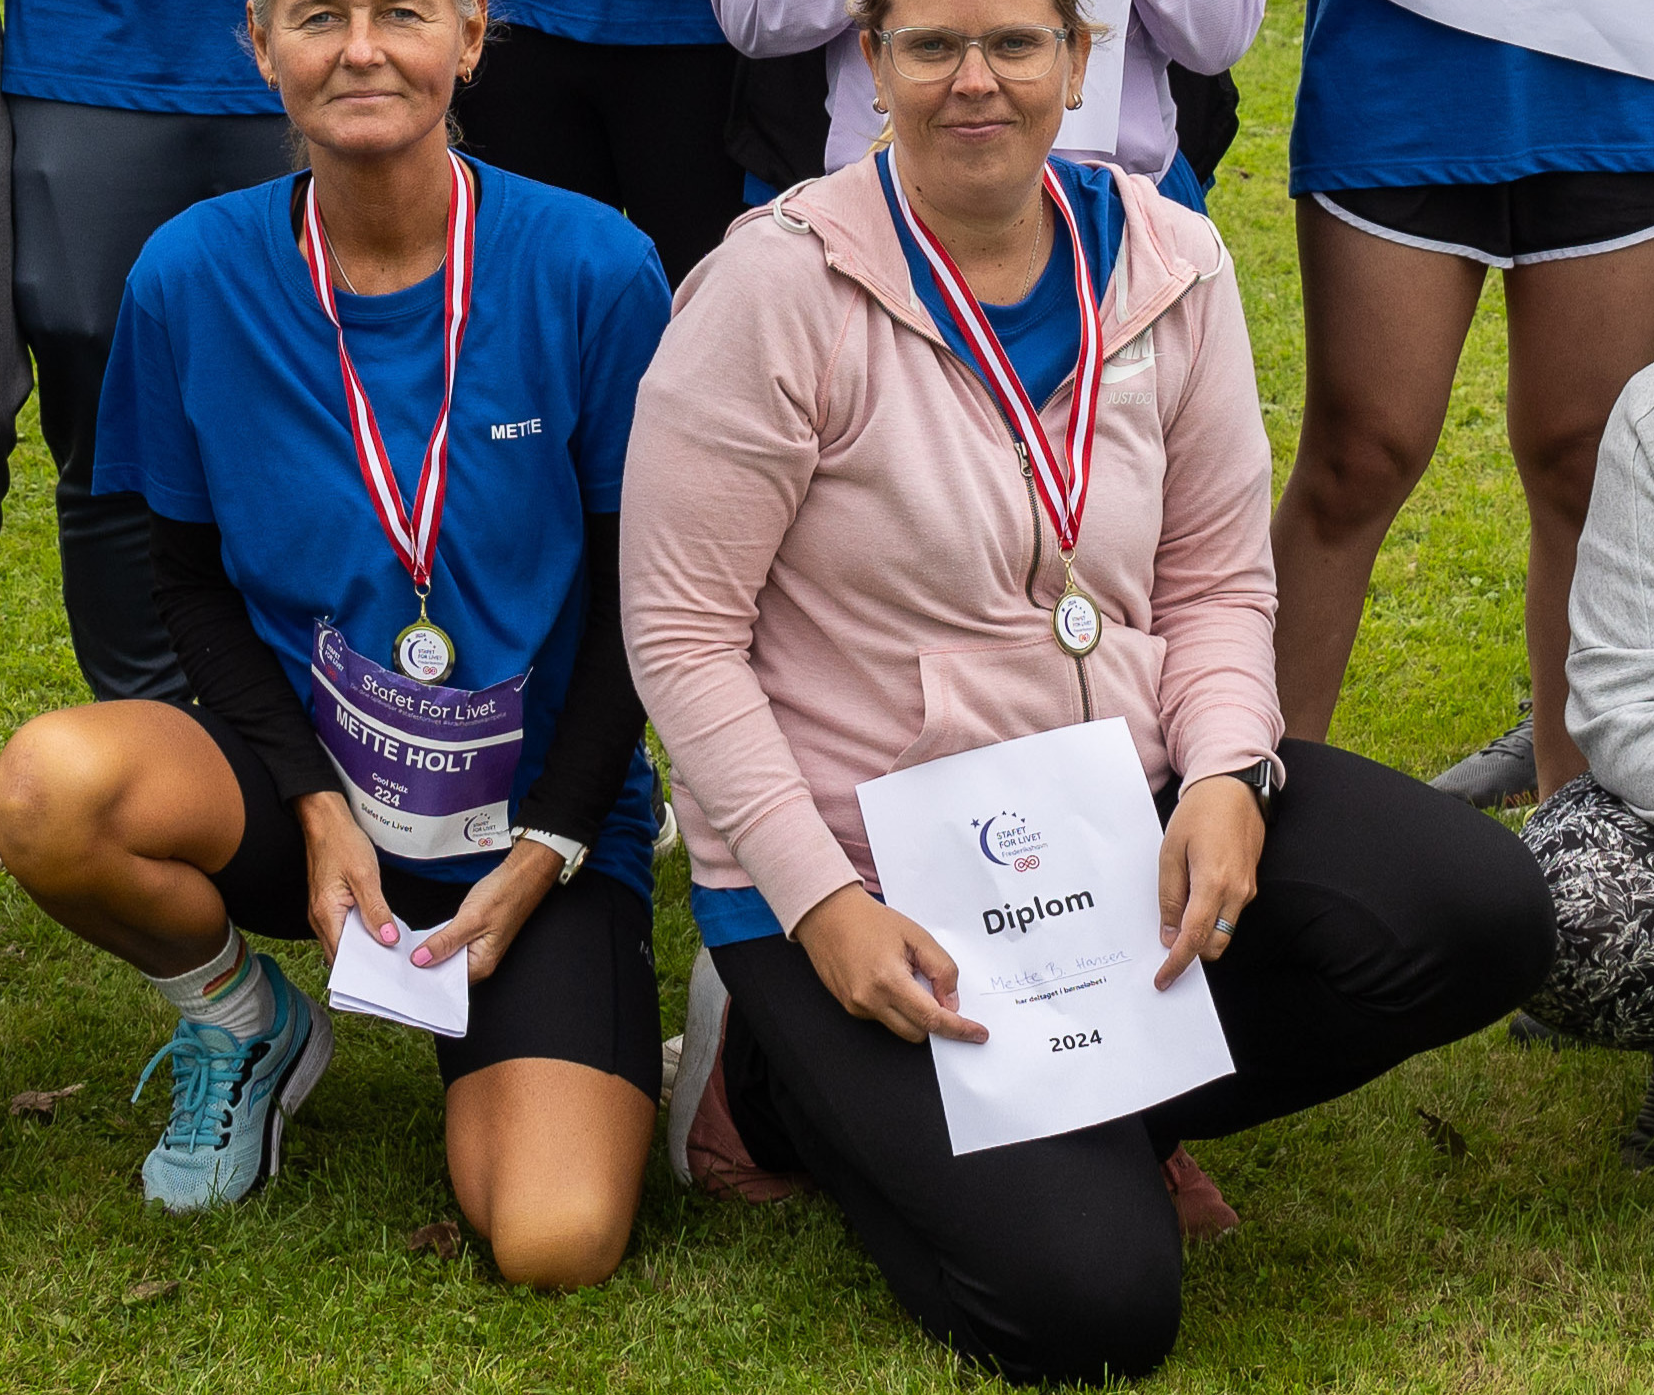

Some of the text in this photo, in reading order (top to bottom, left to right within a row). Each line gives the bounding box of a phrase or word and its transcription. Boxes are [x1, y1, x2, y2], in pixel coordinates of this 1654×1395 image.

[362, 674, 497, 720] Stafet For Livet
[336, 704, 478, 773] METTE HOLT
[371, 772, 409, 794] Cool Kidz
[374, 785, 401, 807] 224
[360, 803, 413, 834] Stafet for Livet
[996, 826, 1026, 840] STAFET
[999, 832, 1042, 849] FOR LIVET
[982, 890, 1095, 935] Diplom
[990, 969, 1043, 990] Mette
[1075, 950, 1128, 969] Hansen
[1015, 997, 1027, 1005] har
[1029, 990, 1059, 1003] deltaget
[1049, 1028, 1103, 1053] 2024
